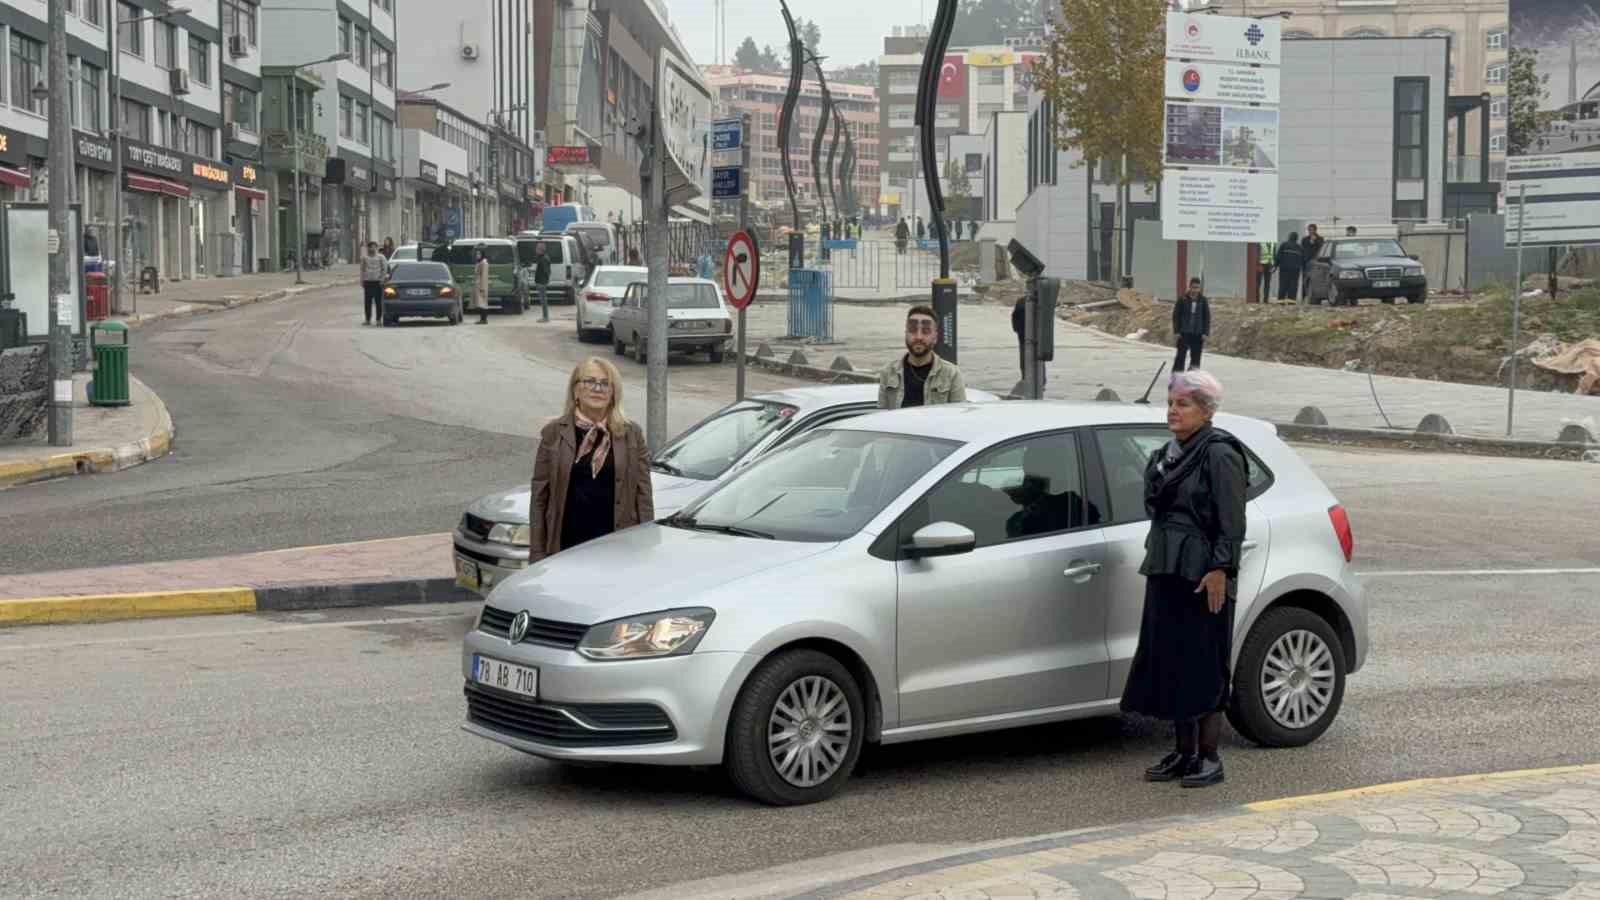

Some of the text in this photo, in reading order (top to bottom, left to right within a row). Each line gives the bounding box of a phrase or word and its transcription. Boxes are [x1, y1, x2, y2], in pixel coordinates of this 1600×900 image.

[480, 660, 533, 693] 78 AB 710
